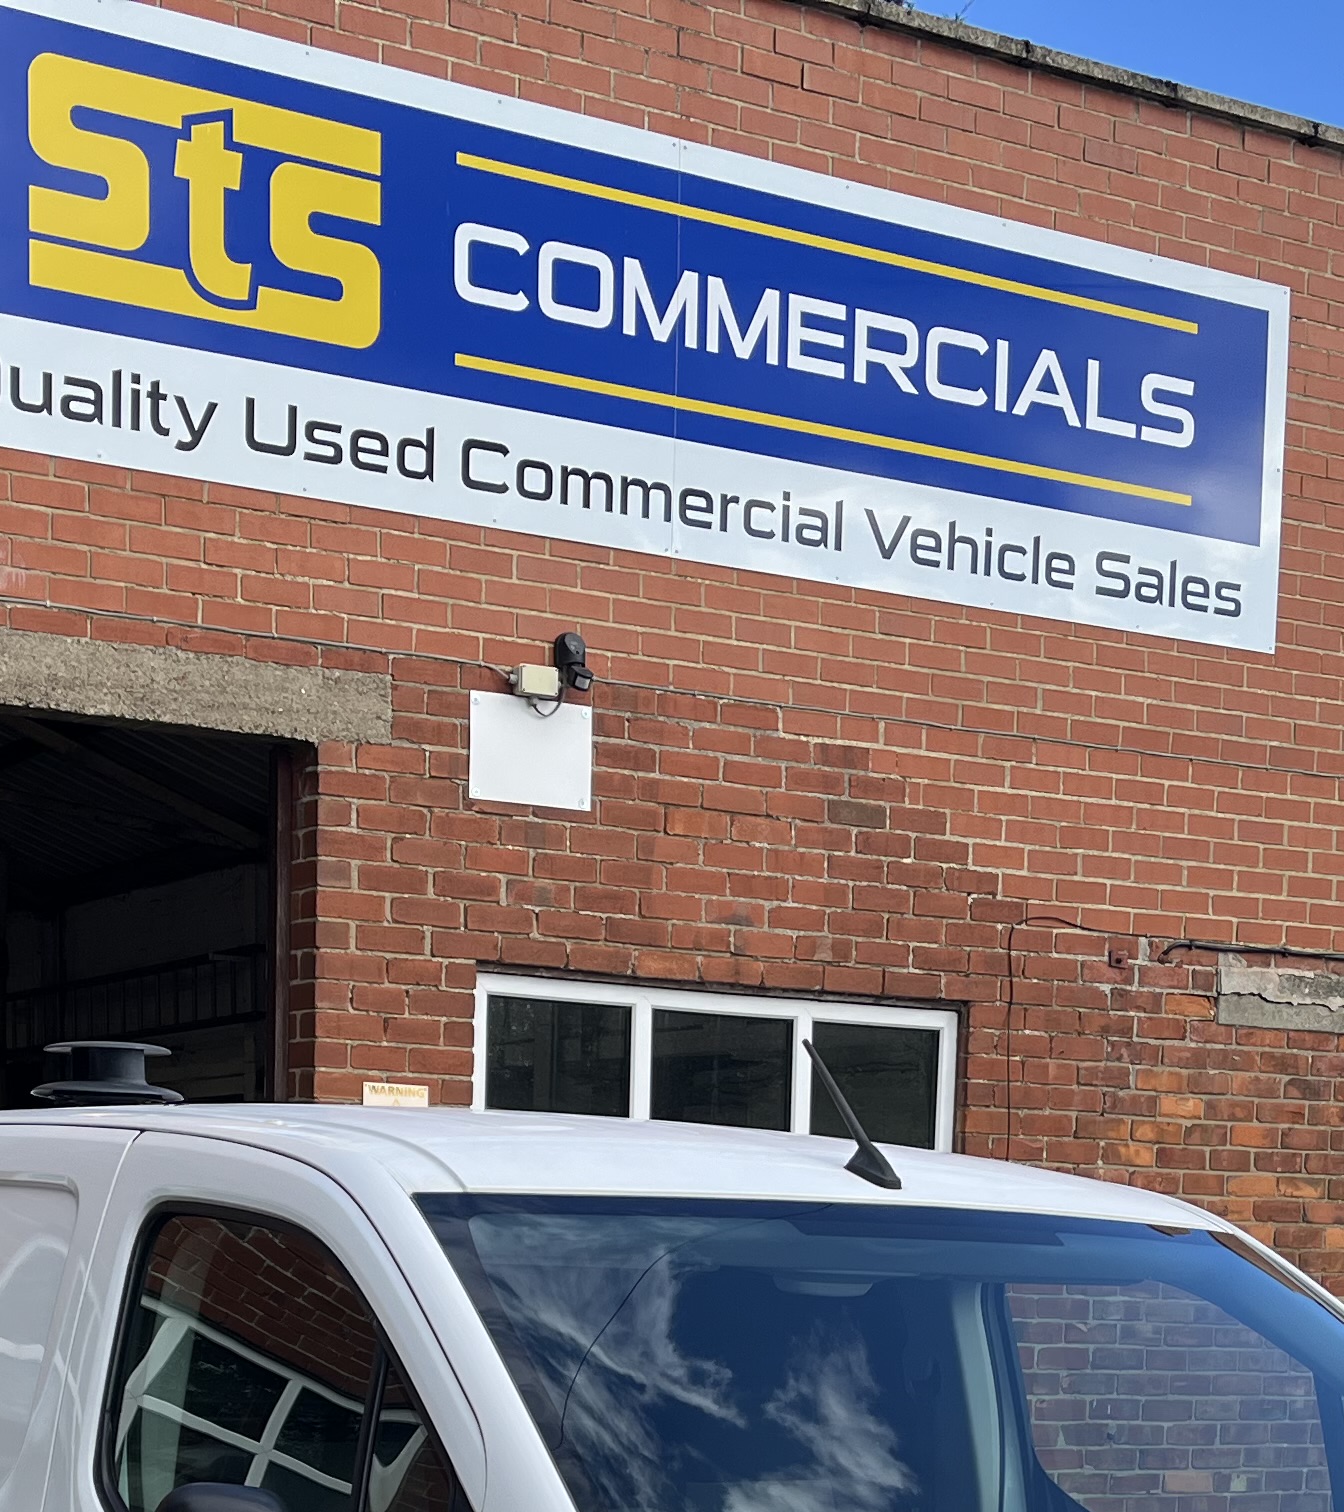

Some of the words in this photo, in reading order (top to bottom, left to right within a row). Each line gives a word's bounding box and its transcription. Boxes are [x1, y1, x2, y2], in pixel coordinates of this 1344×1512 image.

[453, 221, 1196, 449] COMMERCIALS
[245, 396, 435, 483] Used
[460, 437, 844, 552] Commercial
[863, 507, 1076, 591] Vehicle
[1095, 550, 1242, 618] Sales
[367, 1084, 425, 1099] WARNING
